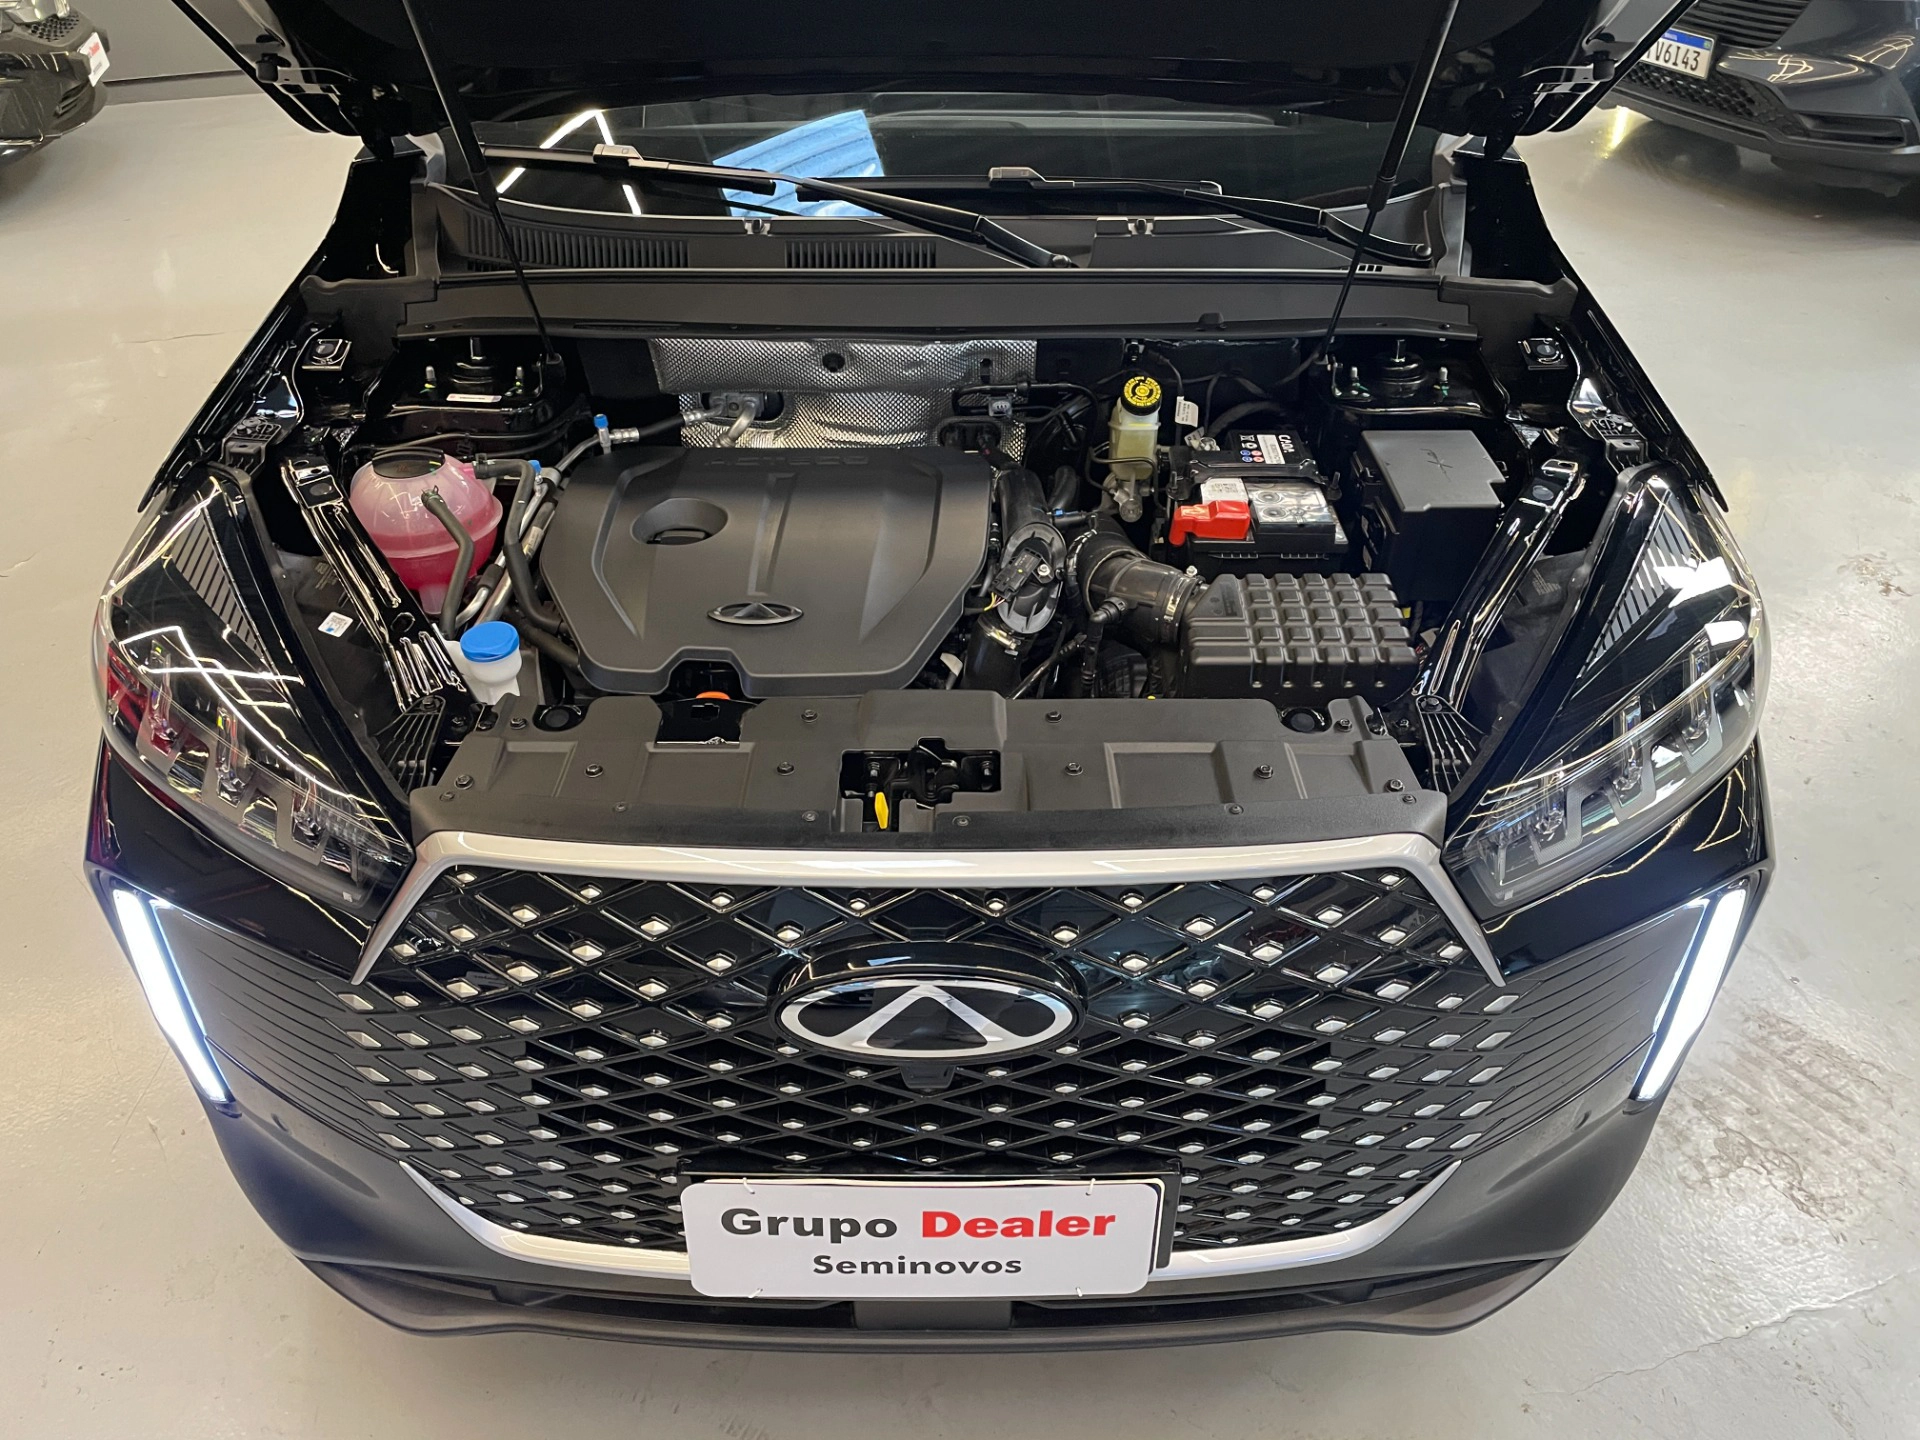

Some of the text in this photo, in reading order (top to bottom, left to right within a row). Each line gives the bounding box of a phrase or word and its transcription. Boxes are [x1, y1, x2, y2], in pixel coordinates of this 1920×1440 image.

[721, 1207, 1117, 1244] Grupo Dealer
[813, 1255, 1022, 1275] Seminovos
